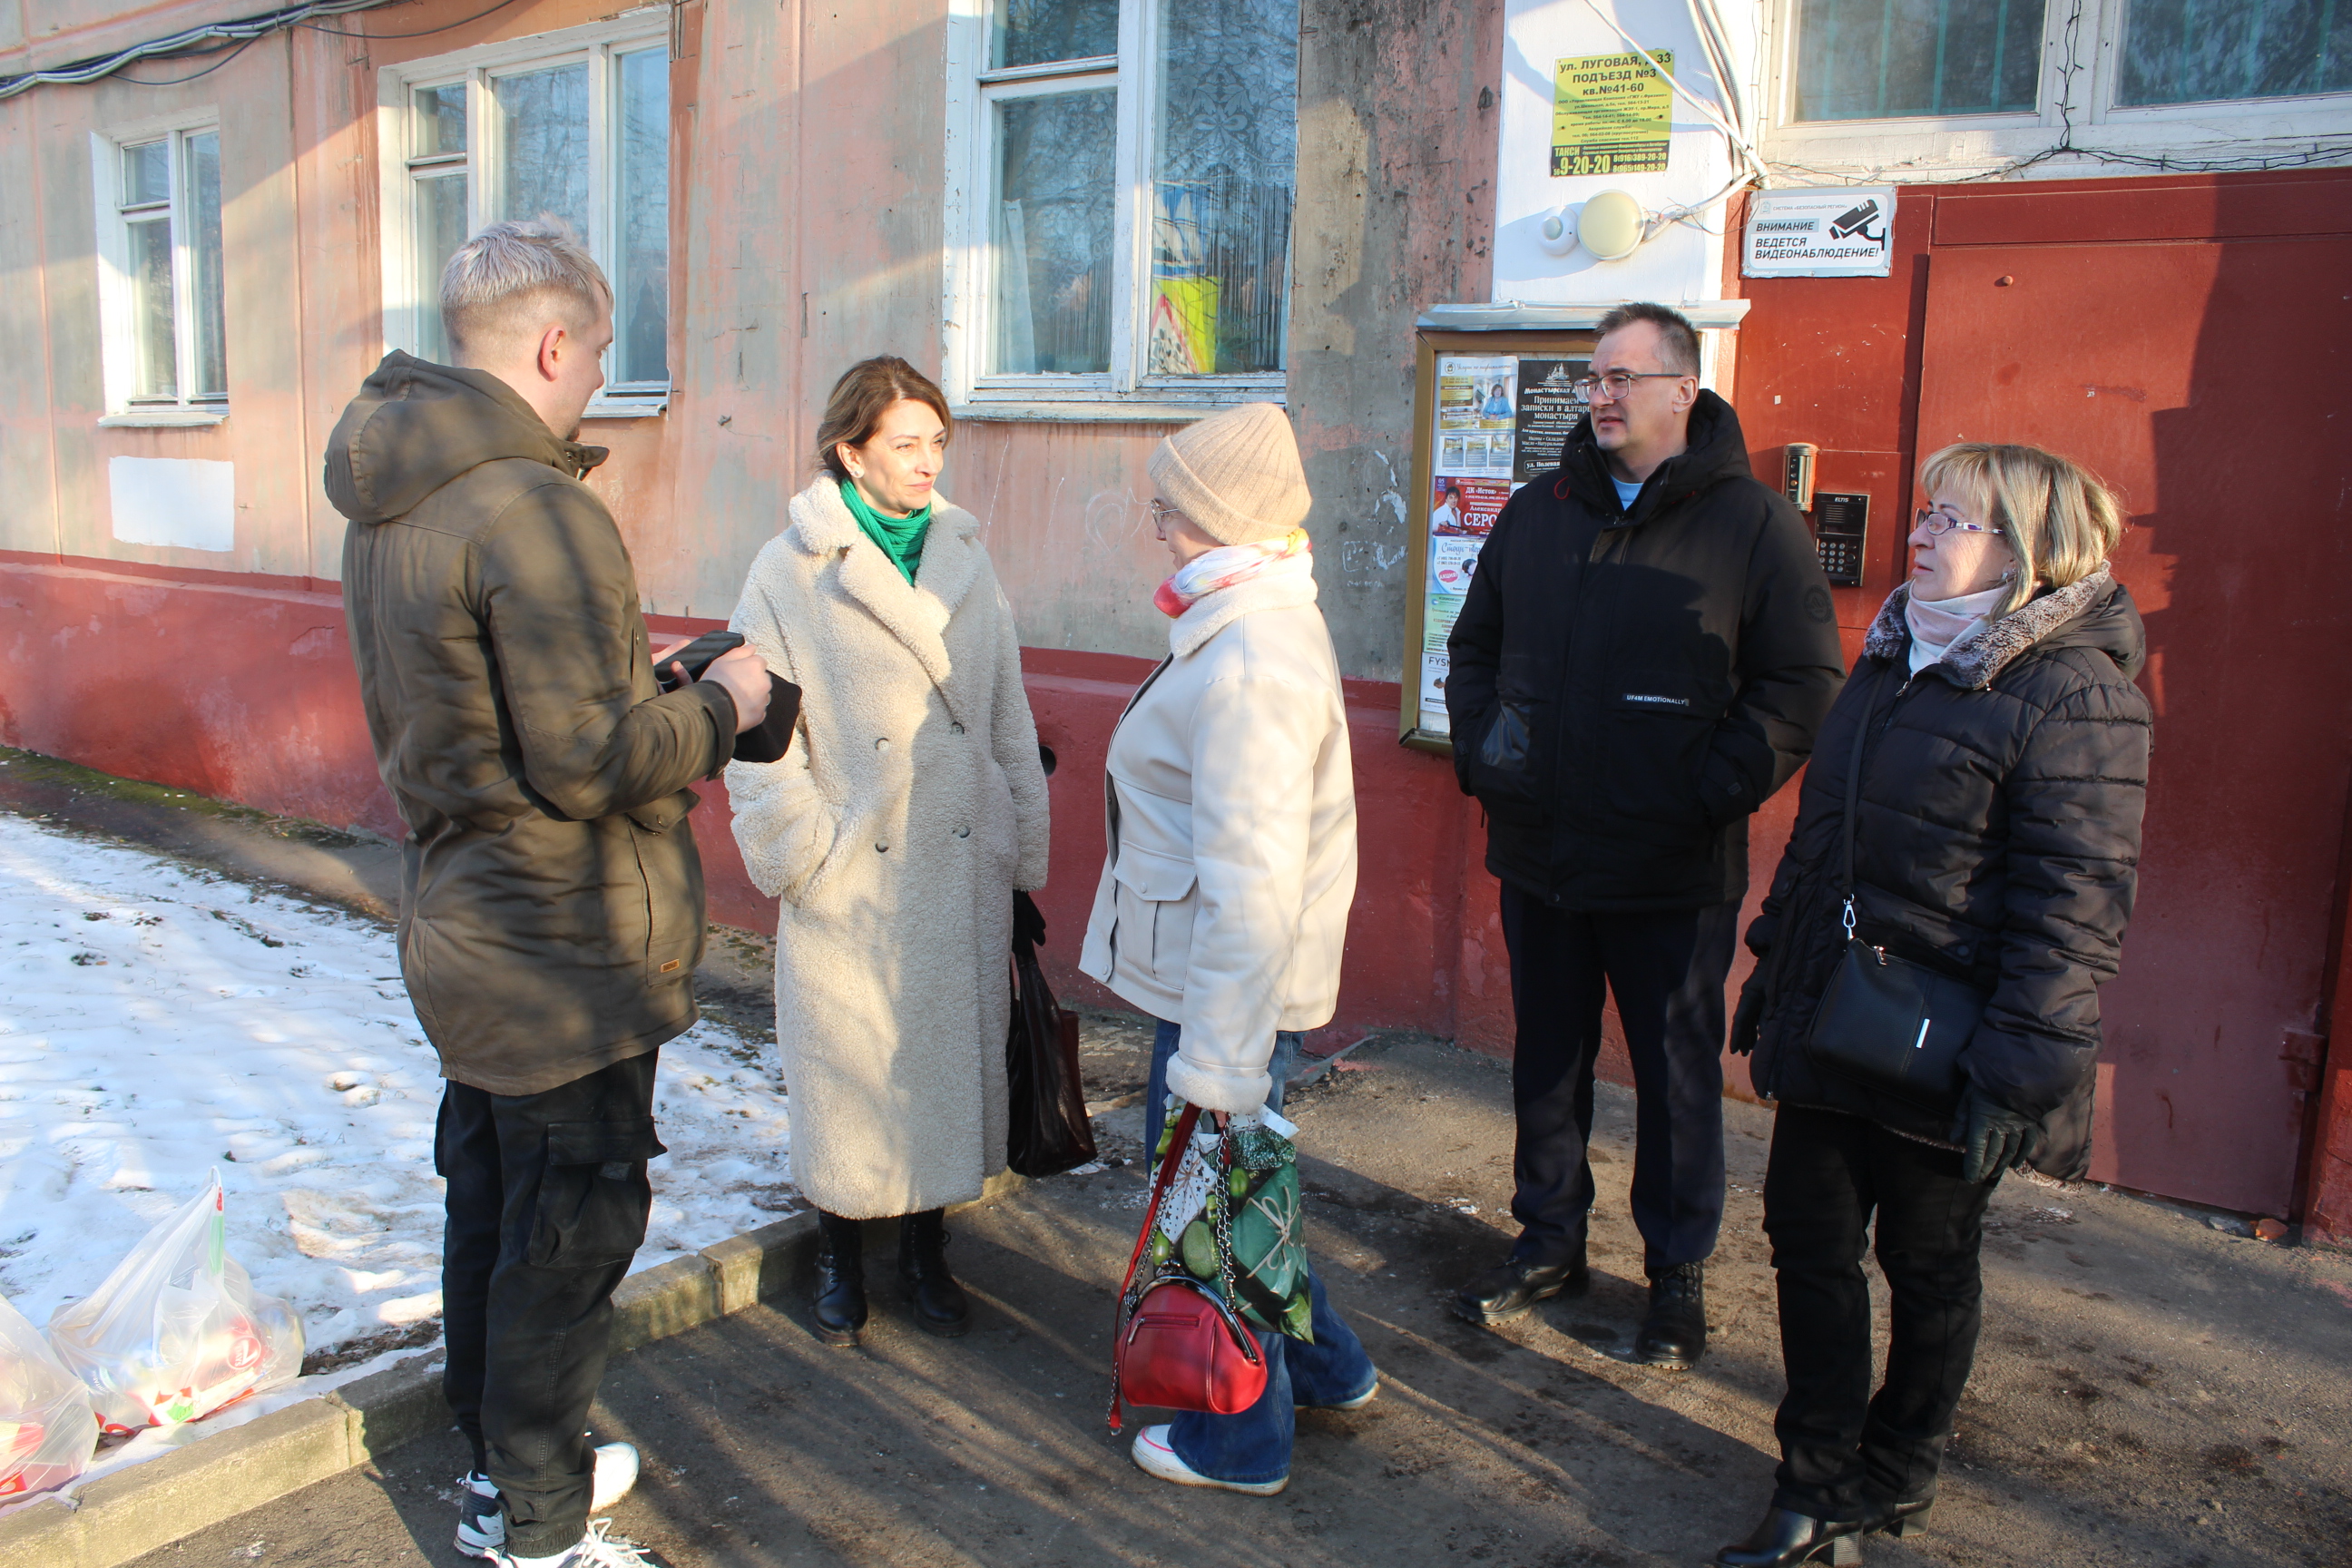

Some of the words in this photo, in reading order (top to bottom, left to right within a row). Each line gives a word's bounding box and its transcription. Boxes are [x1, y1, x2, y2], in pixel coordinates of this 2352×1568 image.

[1560, 64, 1577, 74] ул.
[1580, 55, 1642, 70] ЛУГОВАЯ,
[1657, 53, 1671, 64] 33
[1572, 70, 1632, 83] ПОДЪЕЗД
[1635, 68, 1657, 79] №3
[1583, 83, 1644, 95] кв.№41-60
[1554, 146, 1581, 157] ТАКСИ
[1756, 221, 1815, 232] ВНИМАНИЕ
[1755, 237, 1808, 250] ВЕДЕТСЯ
[1754, 248, 1879, 261] ВИДЕОНАБЛЮДЕНИЕ!
[1534, 396, 1579, 405] Принимаем
[1534, 413, 1579, 422] монастыря
[1526, 462, 1536, 470] ул.
[1465, 486, 1475, 495] ДК
[1476, 487, 1497, 495] «Исток»
[1643, 696, 1685, 704] EMOTIONALLY
